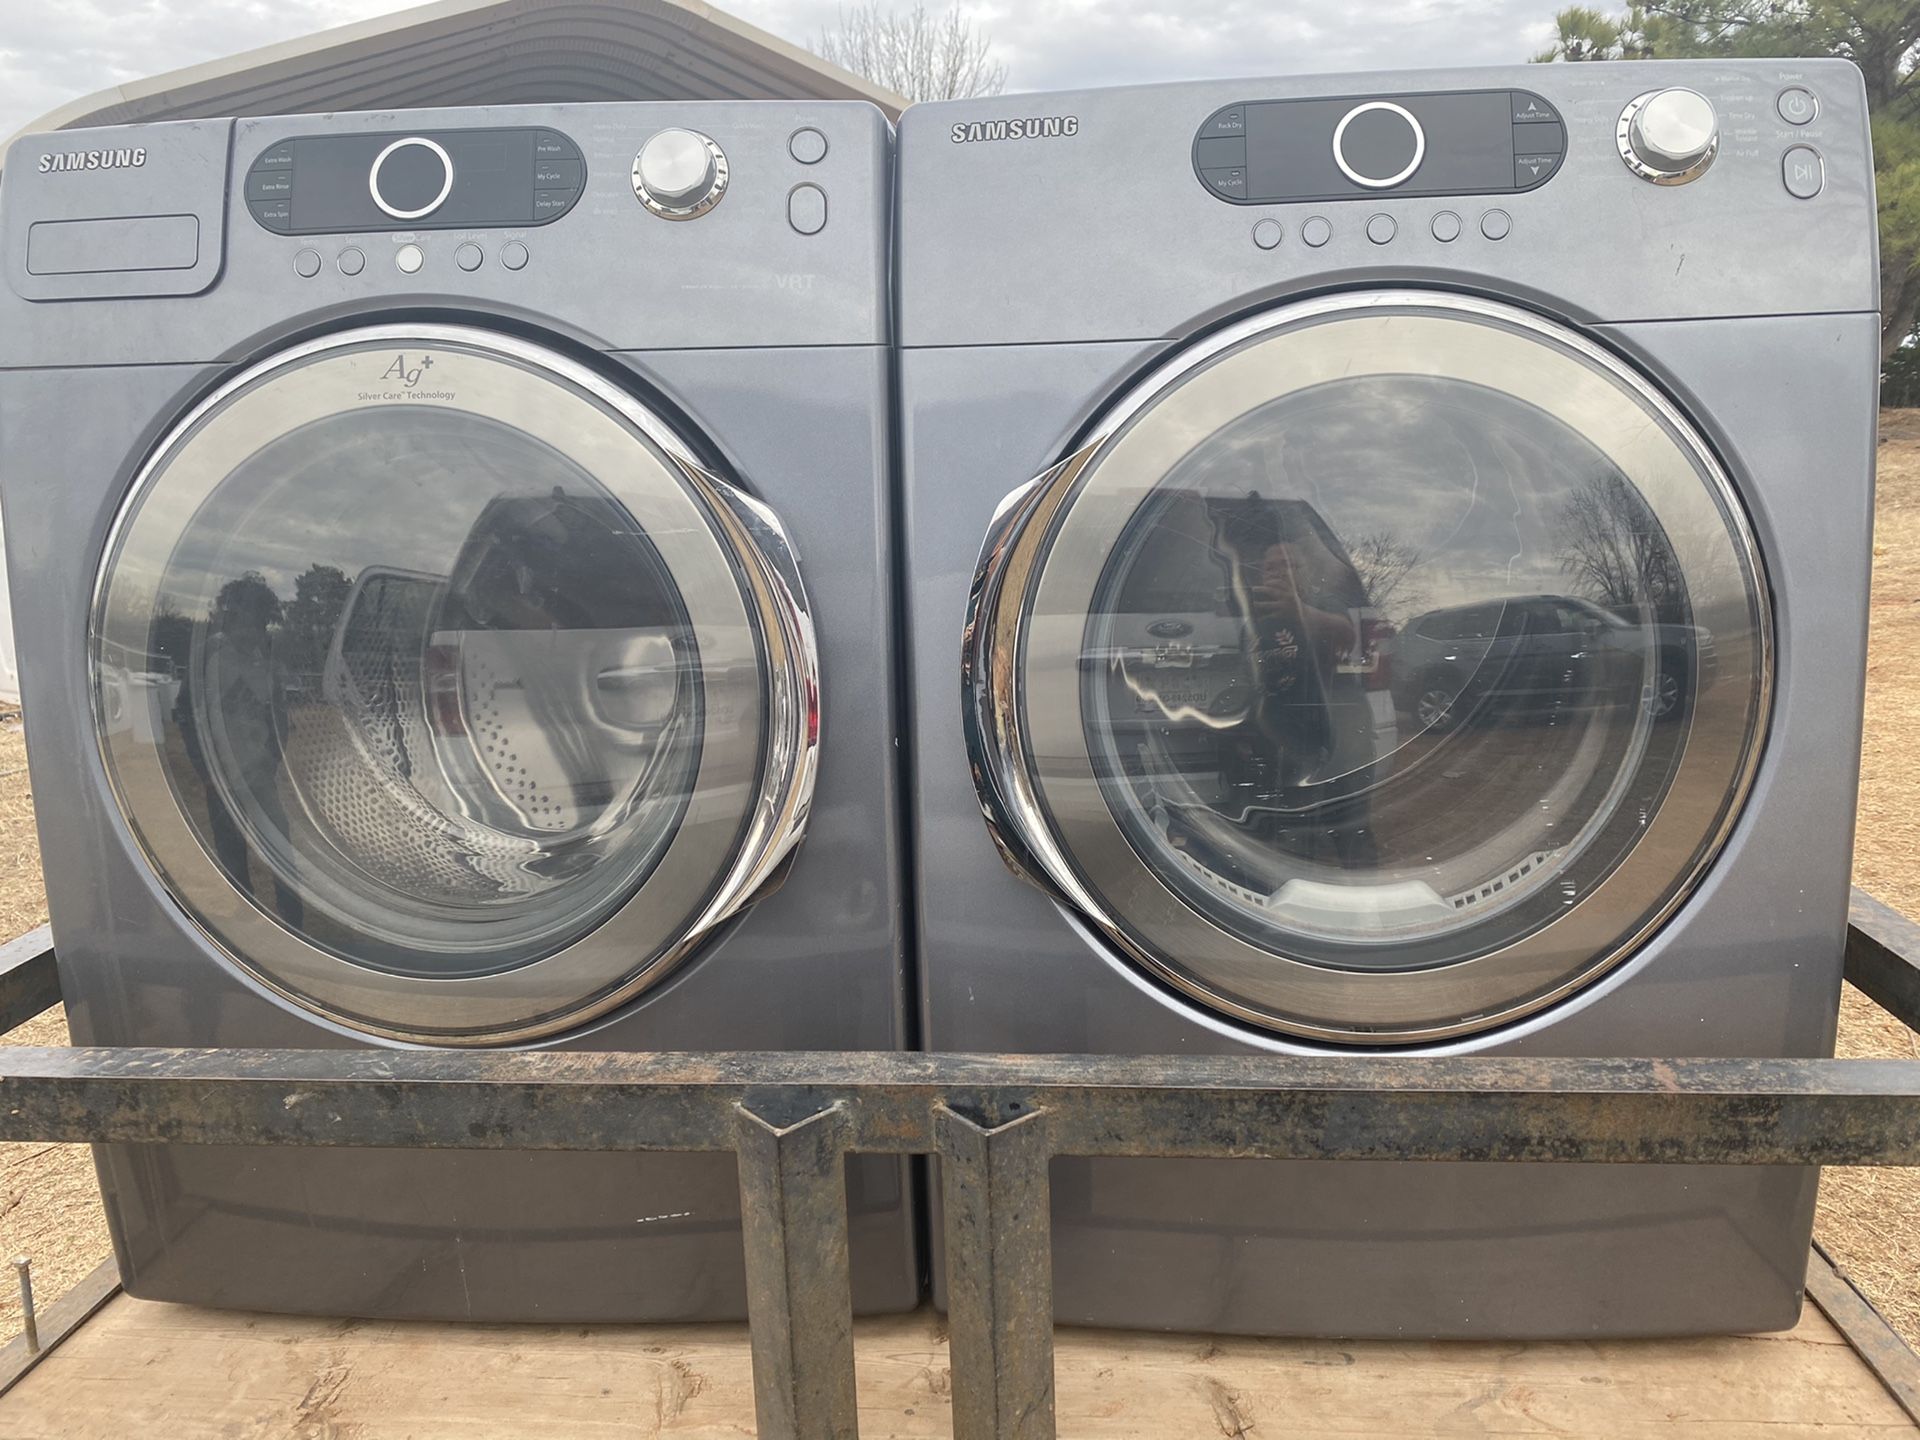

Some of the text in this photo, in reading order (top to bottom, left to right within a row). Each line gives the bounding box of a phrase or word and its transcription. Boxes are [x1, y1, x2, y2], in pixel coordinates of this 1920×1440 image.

[1779, 72, 1802, 80] Power
[951, 115, 1079, 143] SAMSUNG
[1776, 130, 1794, 138] Start
[1800, 130, 1822, 138] Pause
[38, 147, 147, 174] SAMSUNG
[546, 172, 560, 180] Cycle
[536, 200, 551, 208] Delay
[774, 274, 816, 289] VRT
[358, 392, 381, 401] Silver
[406, 390, 456, 401] Technology
